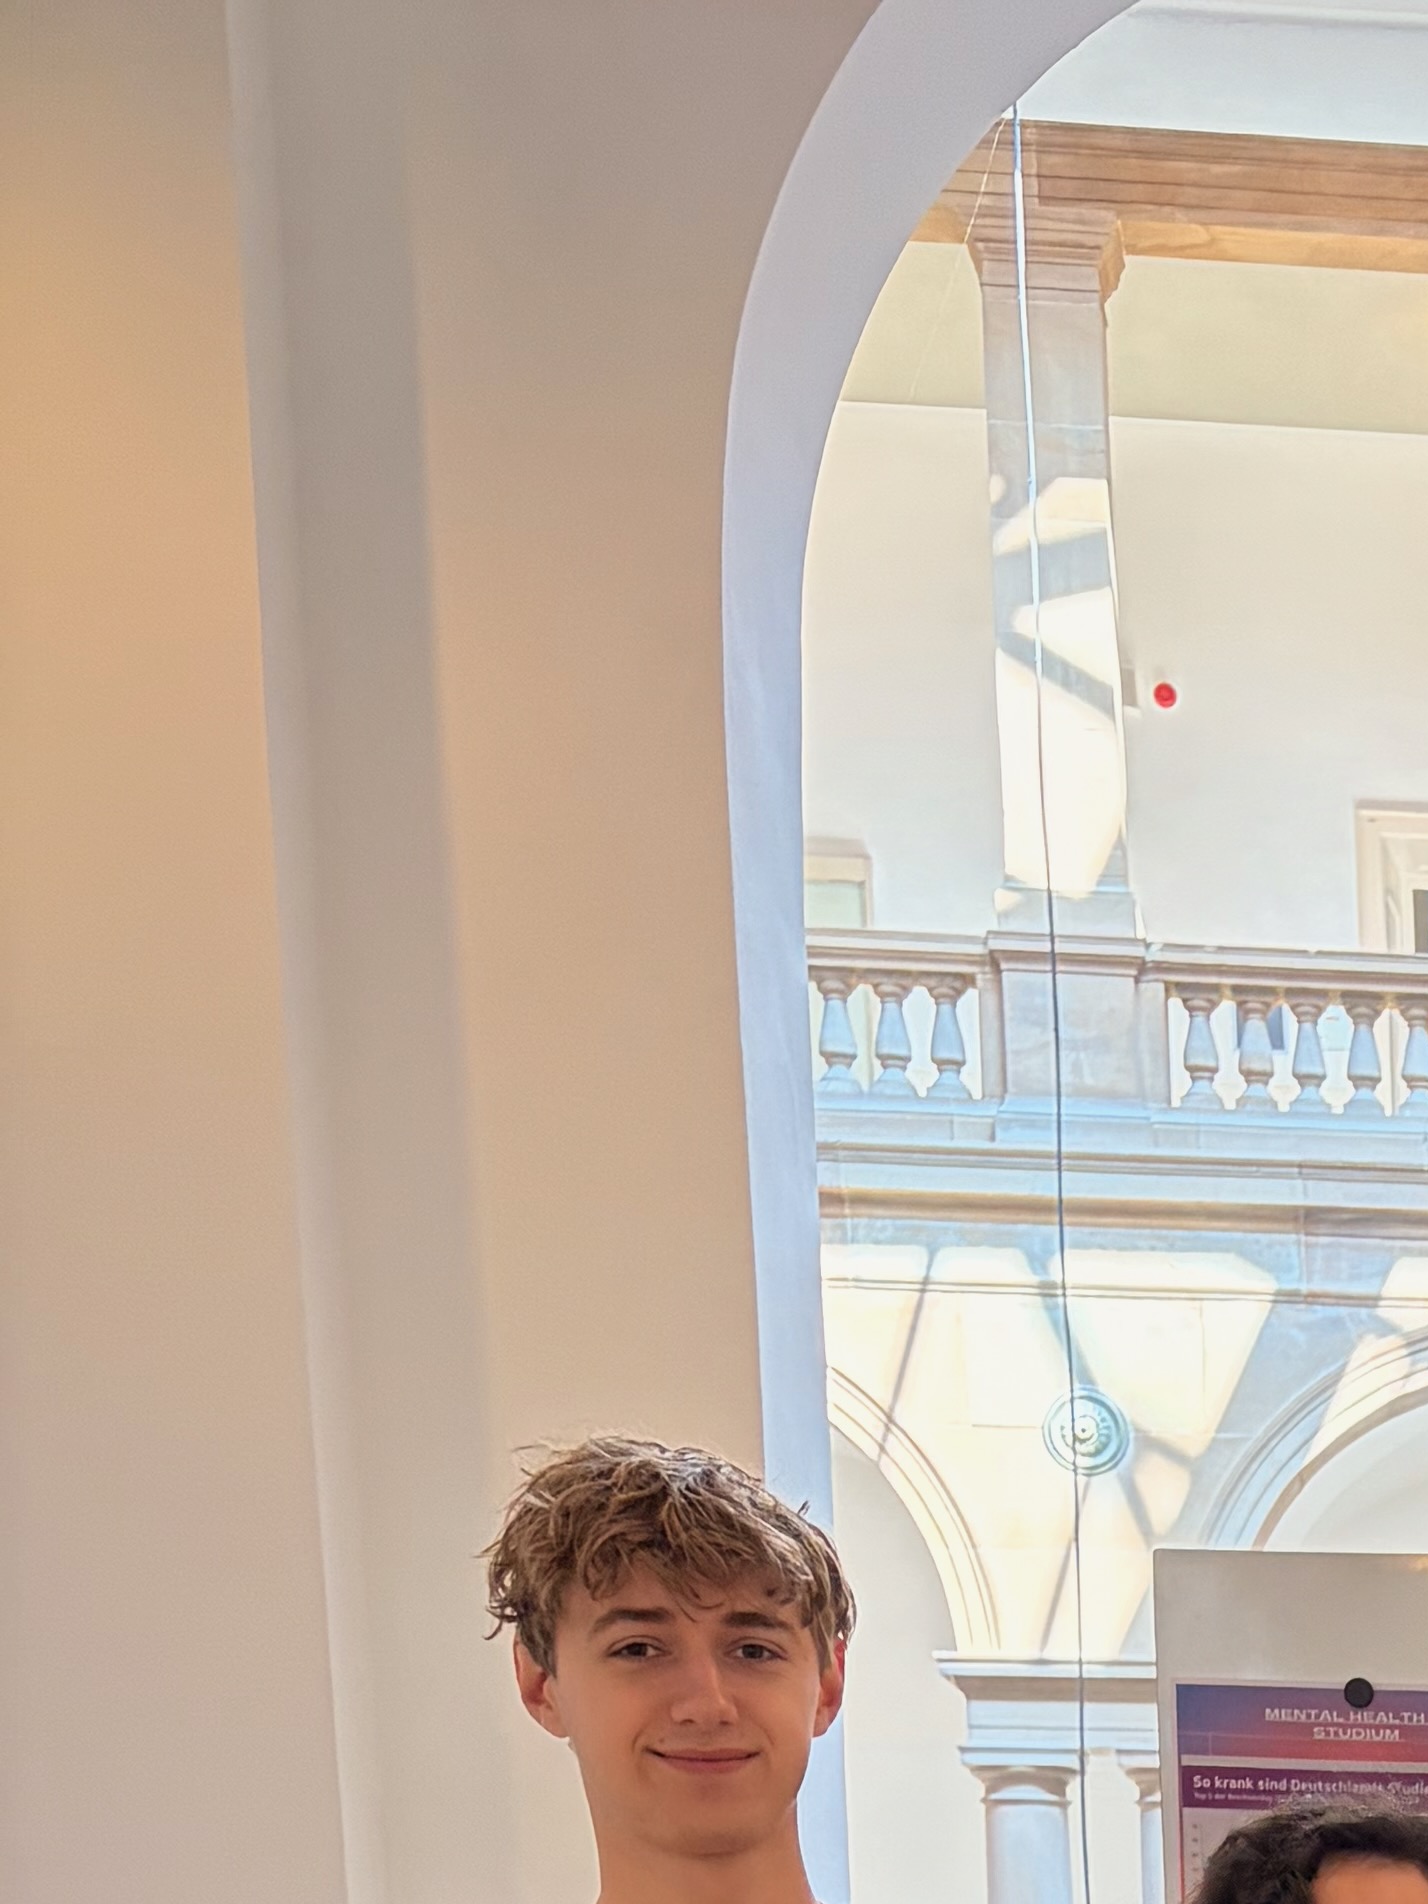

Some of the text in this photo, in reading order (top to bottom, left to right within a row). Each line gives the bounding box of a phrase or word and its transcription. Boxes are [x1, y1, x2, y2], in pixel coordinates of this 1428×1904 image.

[1265, 1708, 1344, 1722] MENTAL
[1350, 1710, 1428, 1724] HEALTH
[1313, 1727, 1400, 1740] STUDIUM
[1193, 1775, 1210, 1789] So
[1215, 1776, 1254, 1790] krank
